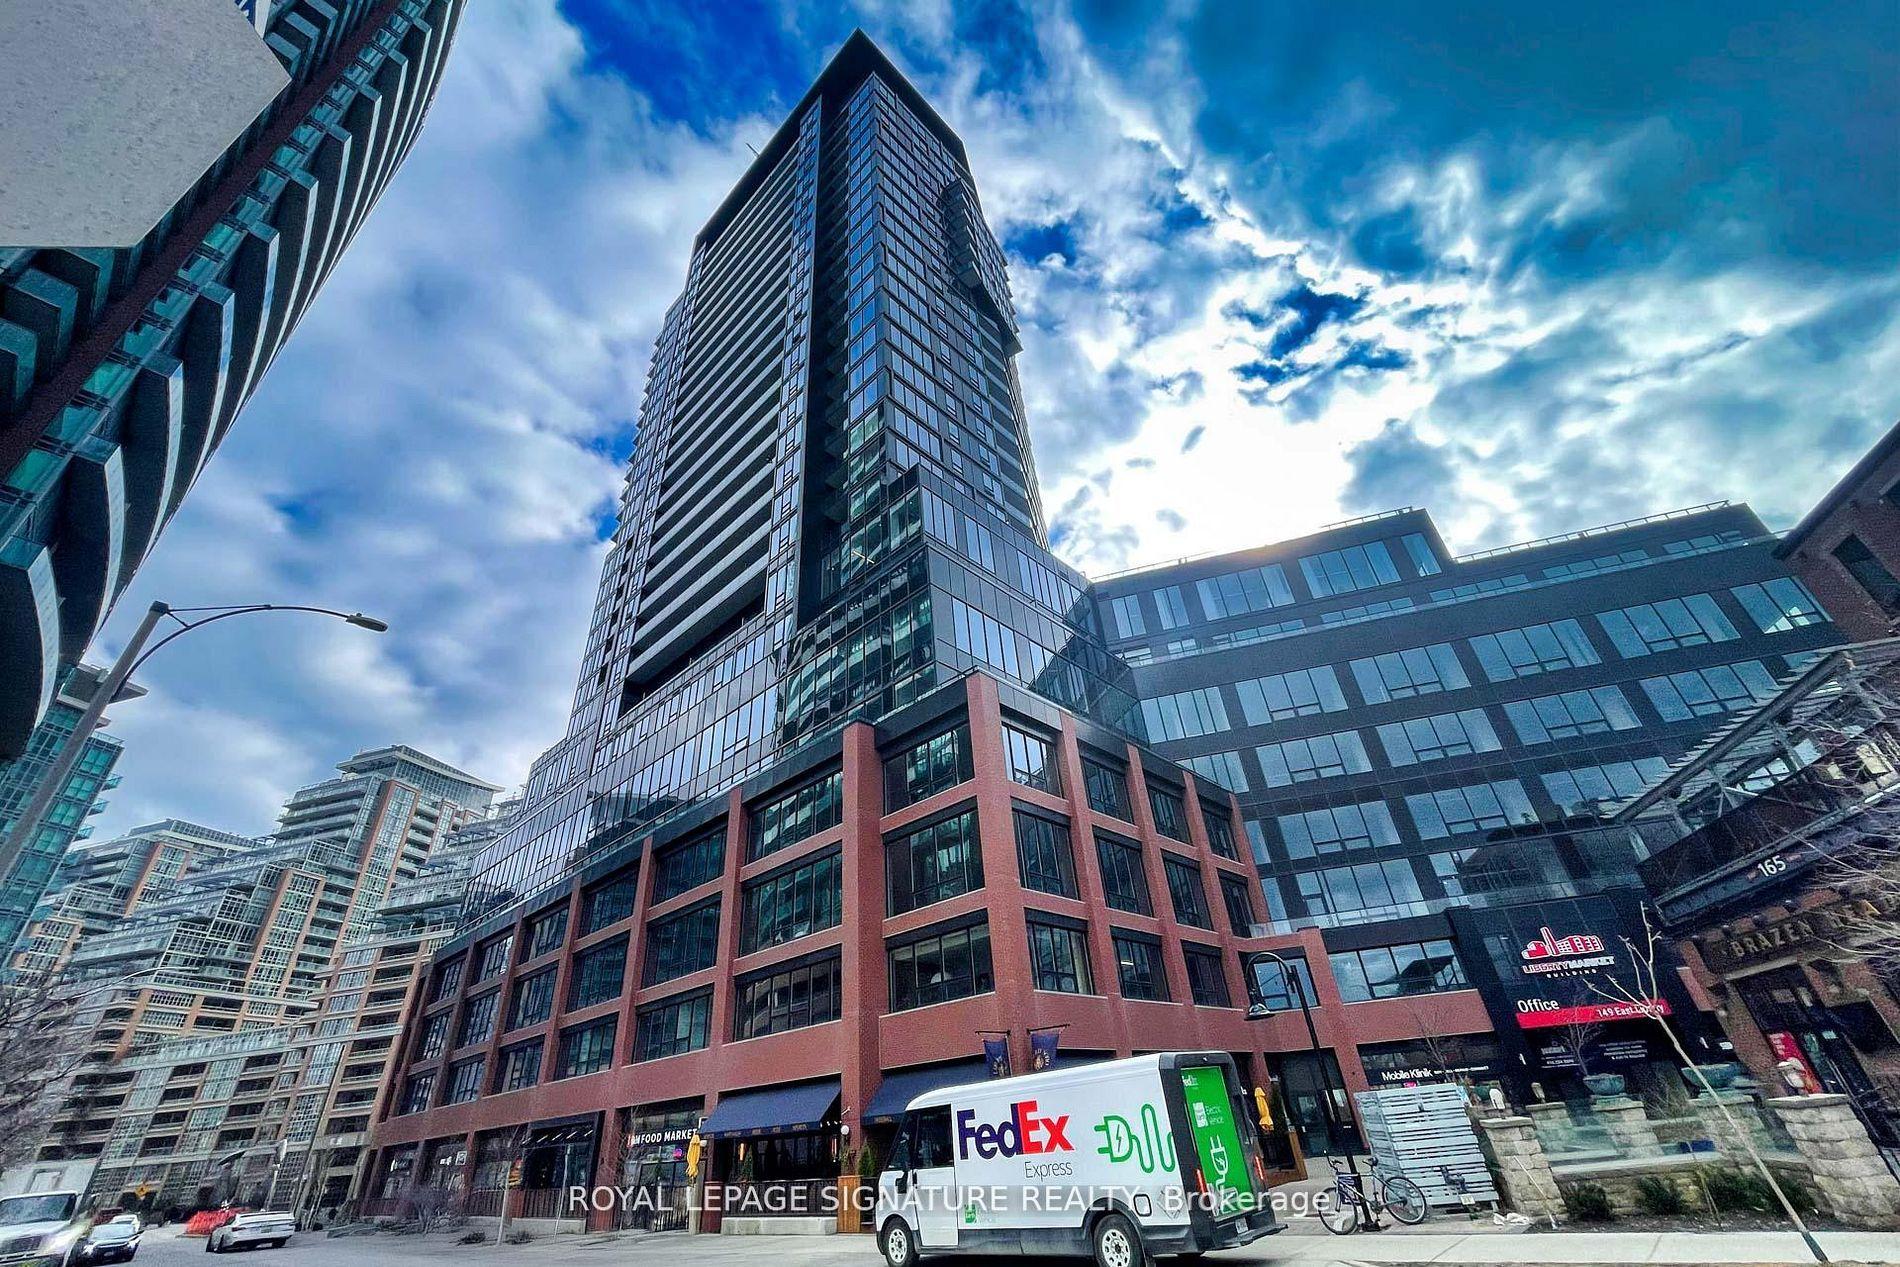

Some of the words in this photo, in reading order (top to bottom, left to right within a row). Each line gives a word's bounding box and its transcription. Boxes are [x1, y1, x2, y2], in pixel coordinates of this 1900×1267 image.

[1757, 855, 1786, 877] 165
[1517, 998, 1560, 1013] Office
[1381, 1070, 1410, 1081] Mobile
[1409, 1067, 1433, 1079] Klinik
[640, 1132, 662, 1144] FOOD
[663, 1128, 698, 1142] MARKET
[956, 1099, 1075, 1161] FedEx
[1024, 1161, 1073, 1182] Express
